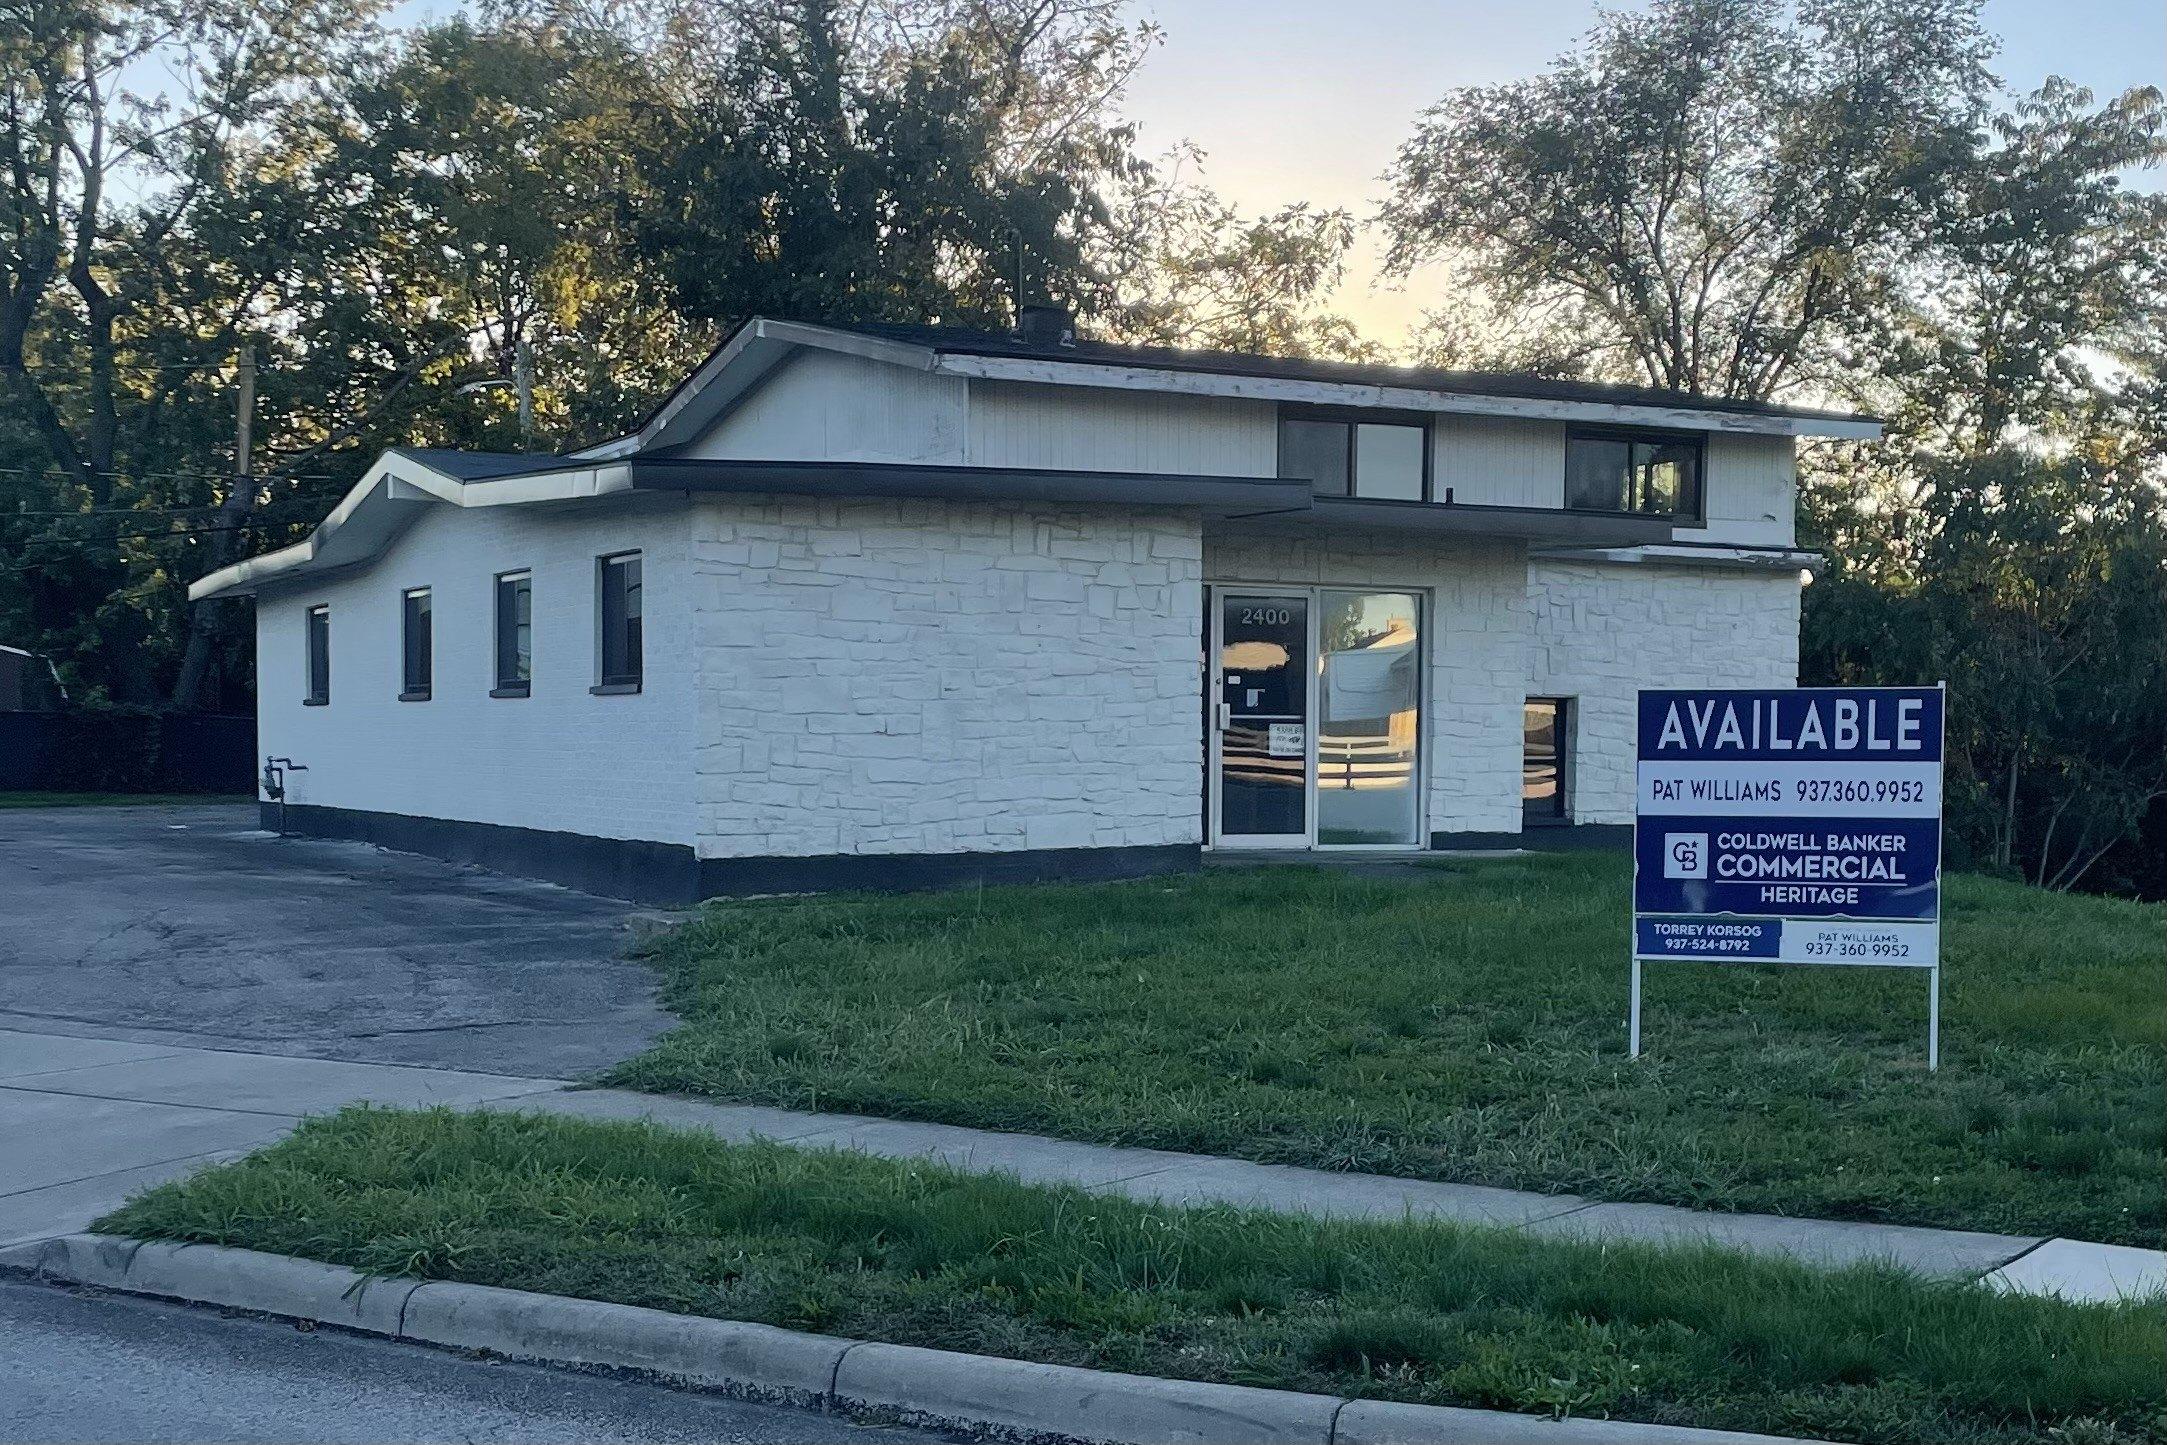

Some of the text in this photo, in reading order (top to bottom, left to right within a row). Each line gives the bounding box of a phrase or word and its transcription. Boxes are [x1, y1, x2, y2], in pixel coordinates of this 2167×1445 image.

[1241, 608, 1290, 625] 2400
[1657, 698, 1923, 750] AVAILABLE
[1653, 780, 1924, 802] PAT WILLIAMS 937.360.9952
[1717, 833, 1906, 852] COLDWELL BANKER
[1717, 854, 1906, 880] COMMERCIAL
[1761, 887, 1859, 904] HERITAGE
[1654, 923, 1762, 937] TORREY KORSOG
[1818, 933, 1899, 942] PAT WILLIAMS
[1665, 938, 1750, 951] 937-524-8792
